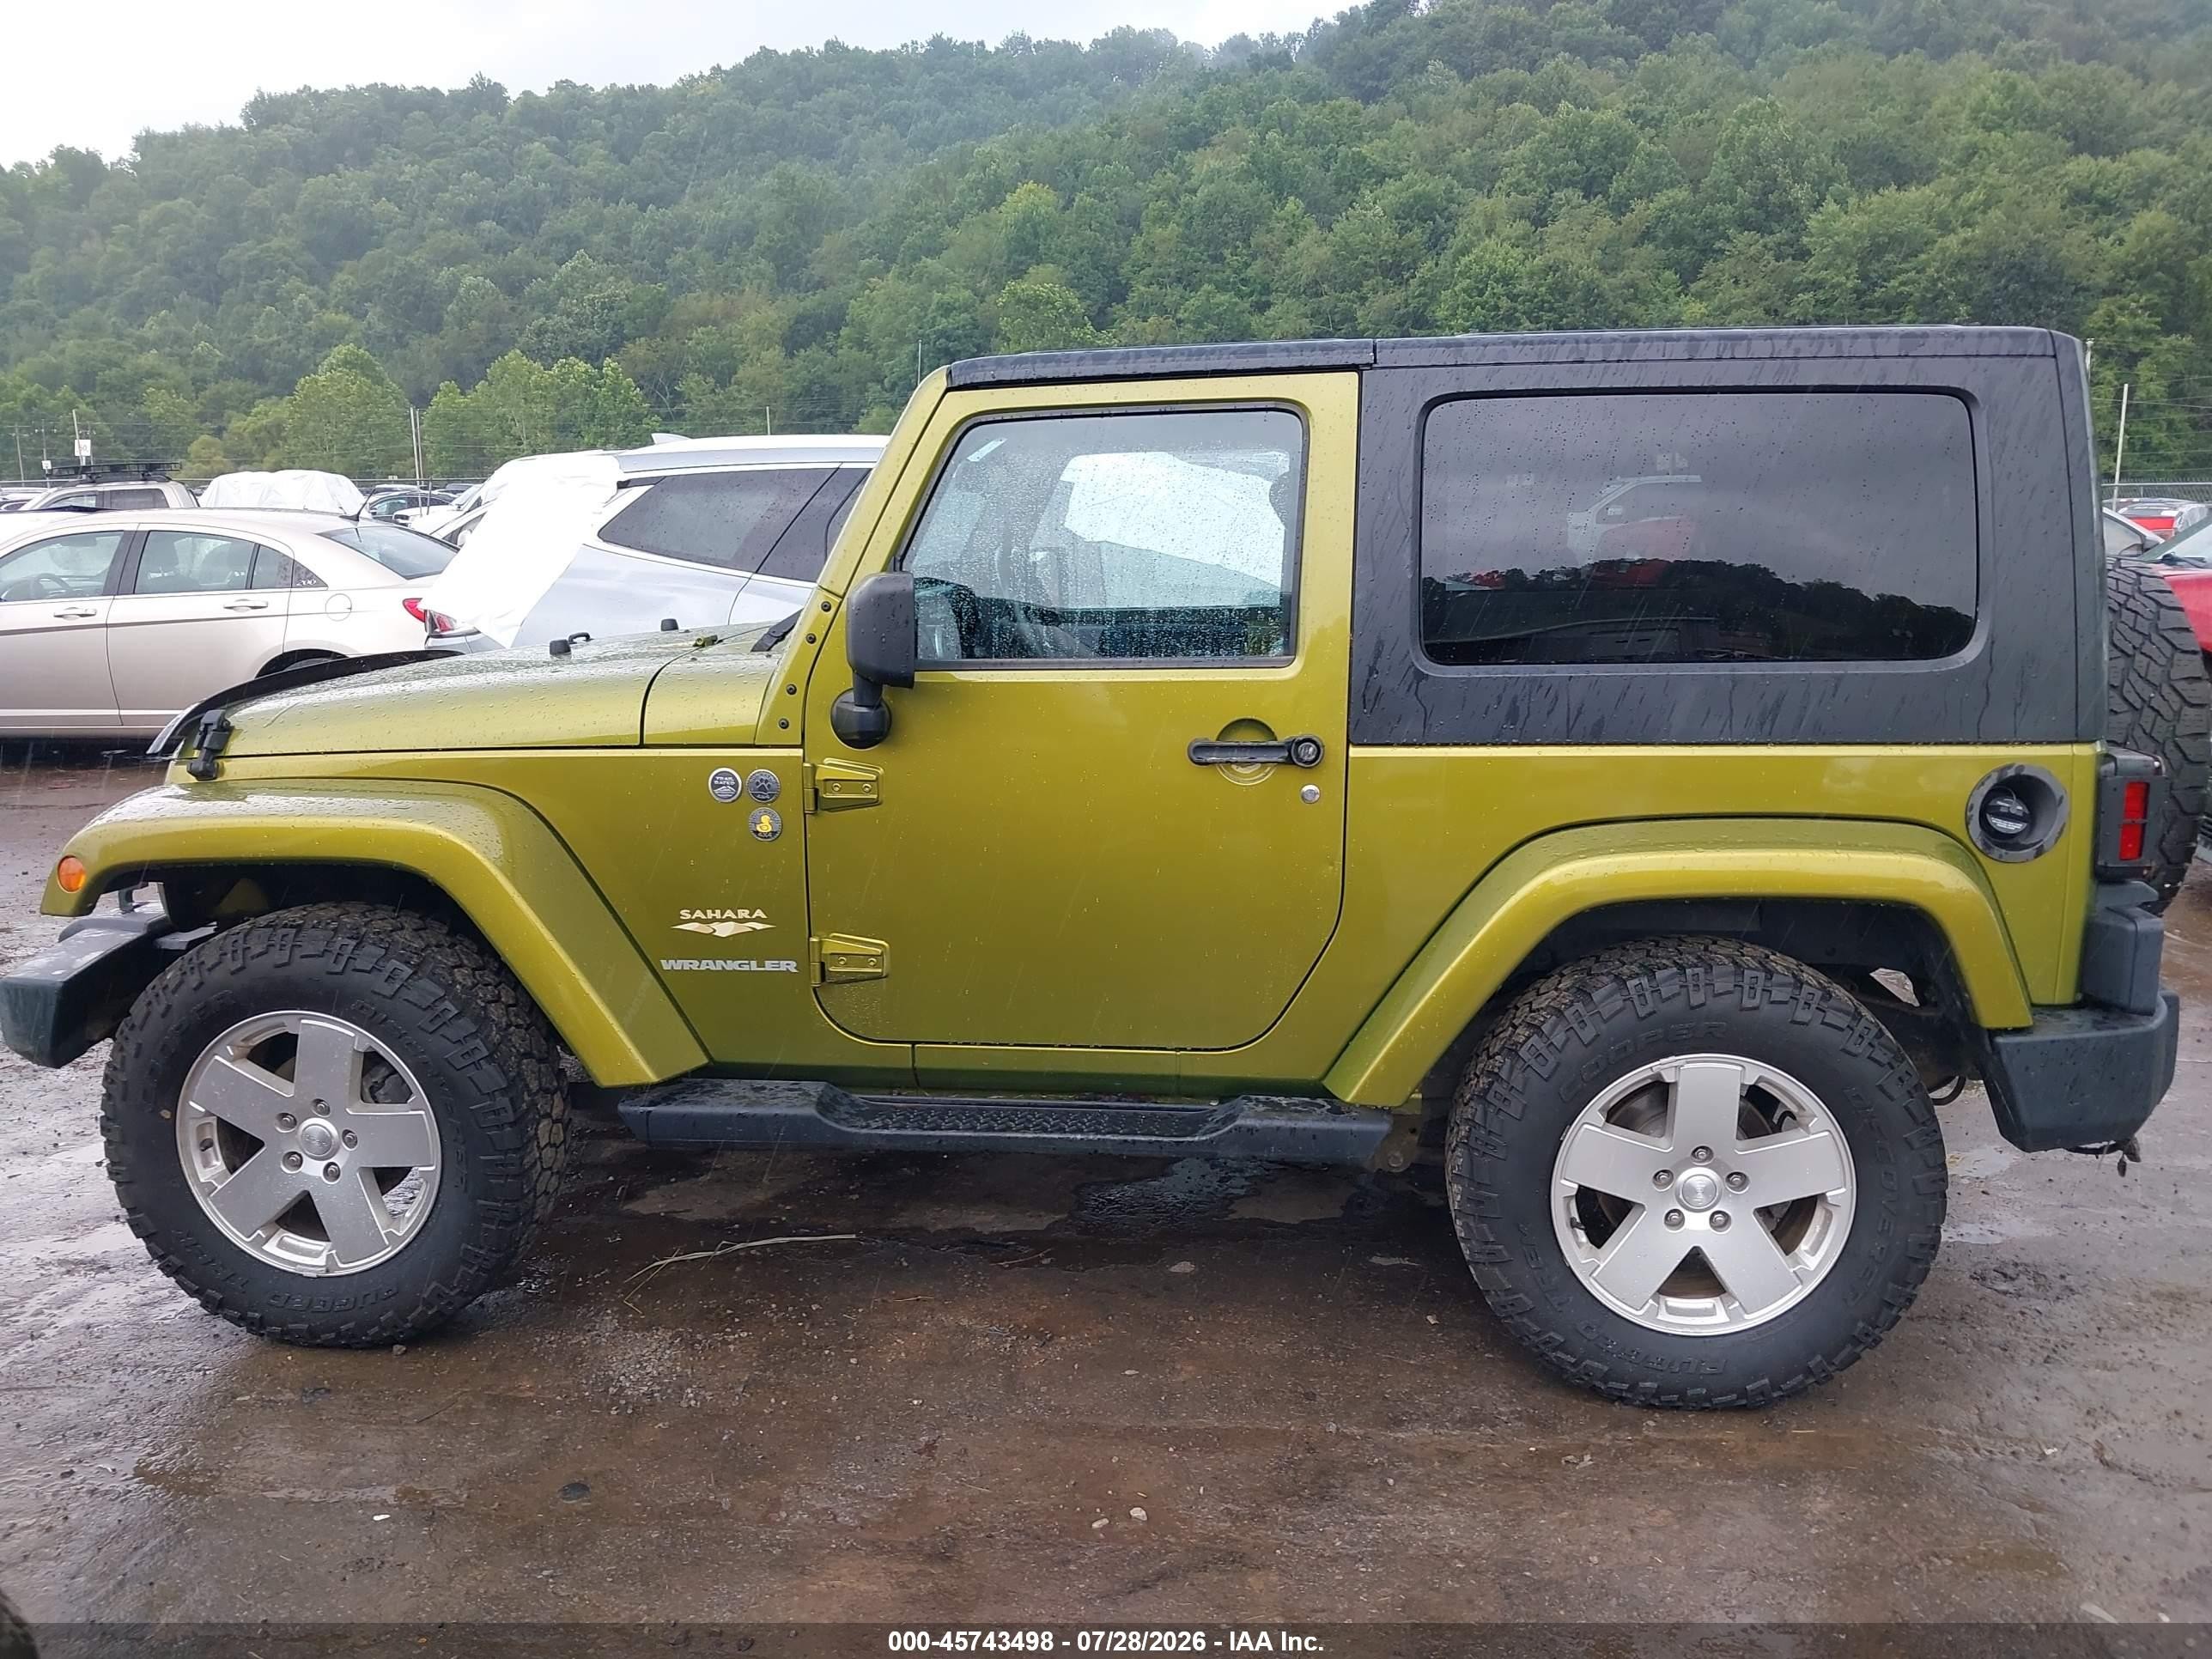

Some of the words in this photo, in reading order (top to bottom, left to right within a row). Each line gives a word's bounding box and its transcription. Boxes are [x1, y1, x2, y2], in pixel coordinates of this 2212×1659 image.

[679, 908, 768, 920] SAHARA
[659, 959, 799, 973] WRANGLER
[1558, 1021, 1729, 1103] COOPER
[1575, 1319, 1729, 1375] RUGGED
